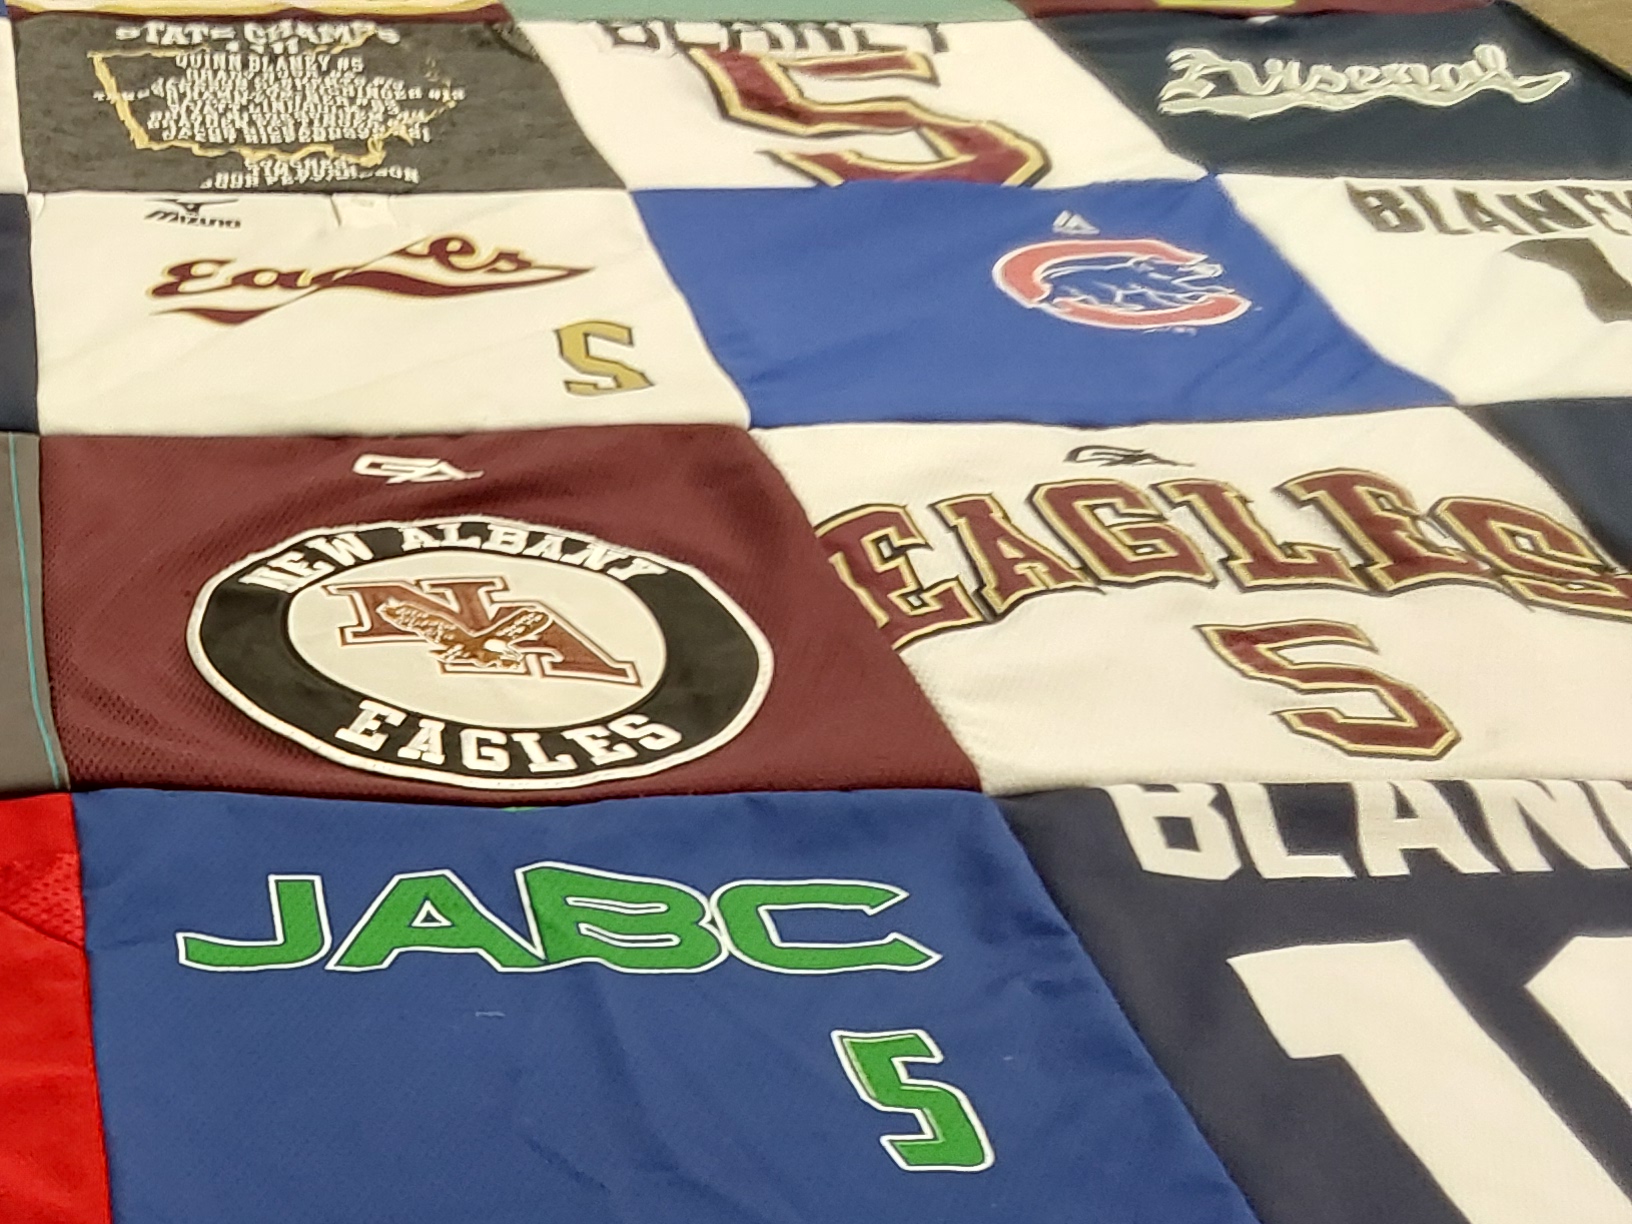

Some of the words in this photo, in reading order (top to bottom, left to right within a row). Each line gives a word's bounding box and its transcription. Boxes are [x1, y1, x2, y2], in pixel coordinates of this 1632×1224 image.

[676, 46, 1054, 188] 5
[1158, 43, 1538, 108] Arsenal
[1344, 181, 1632, 237] BLANE
[239, 533, 372, 594] NEW
[401, 521, 670, 582] ALBANY
[812, 467, 1632, 652] EAGLES
[335, 699, 684, 774] EAGLES
[1194, 618, 1463, 762] 5
[1103, 779, 1632, 881] BLAN
[176, 860, 943, 975] JABC
[830, 1028, 996, 1172] 5
